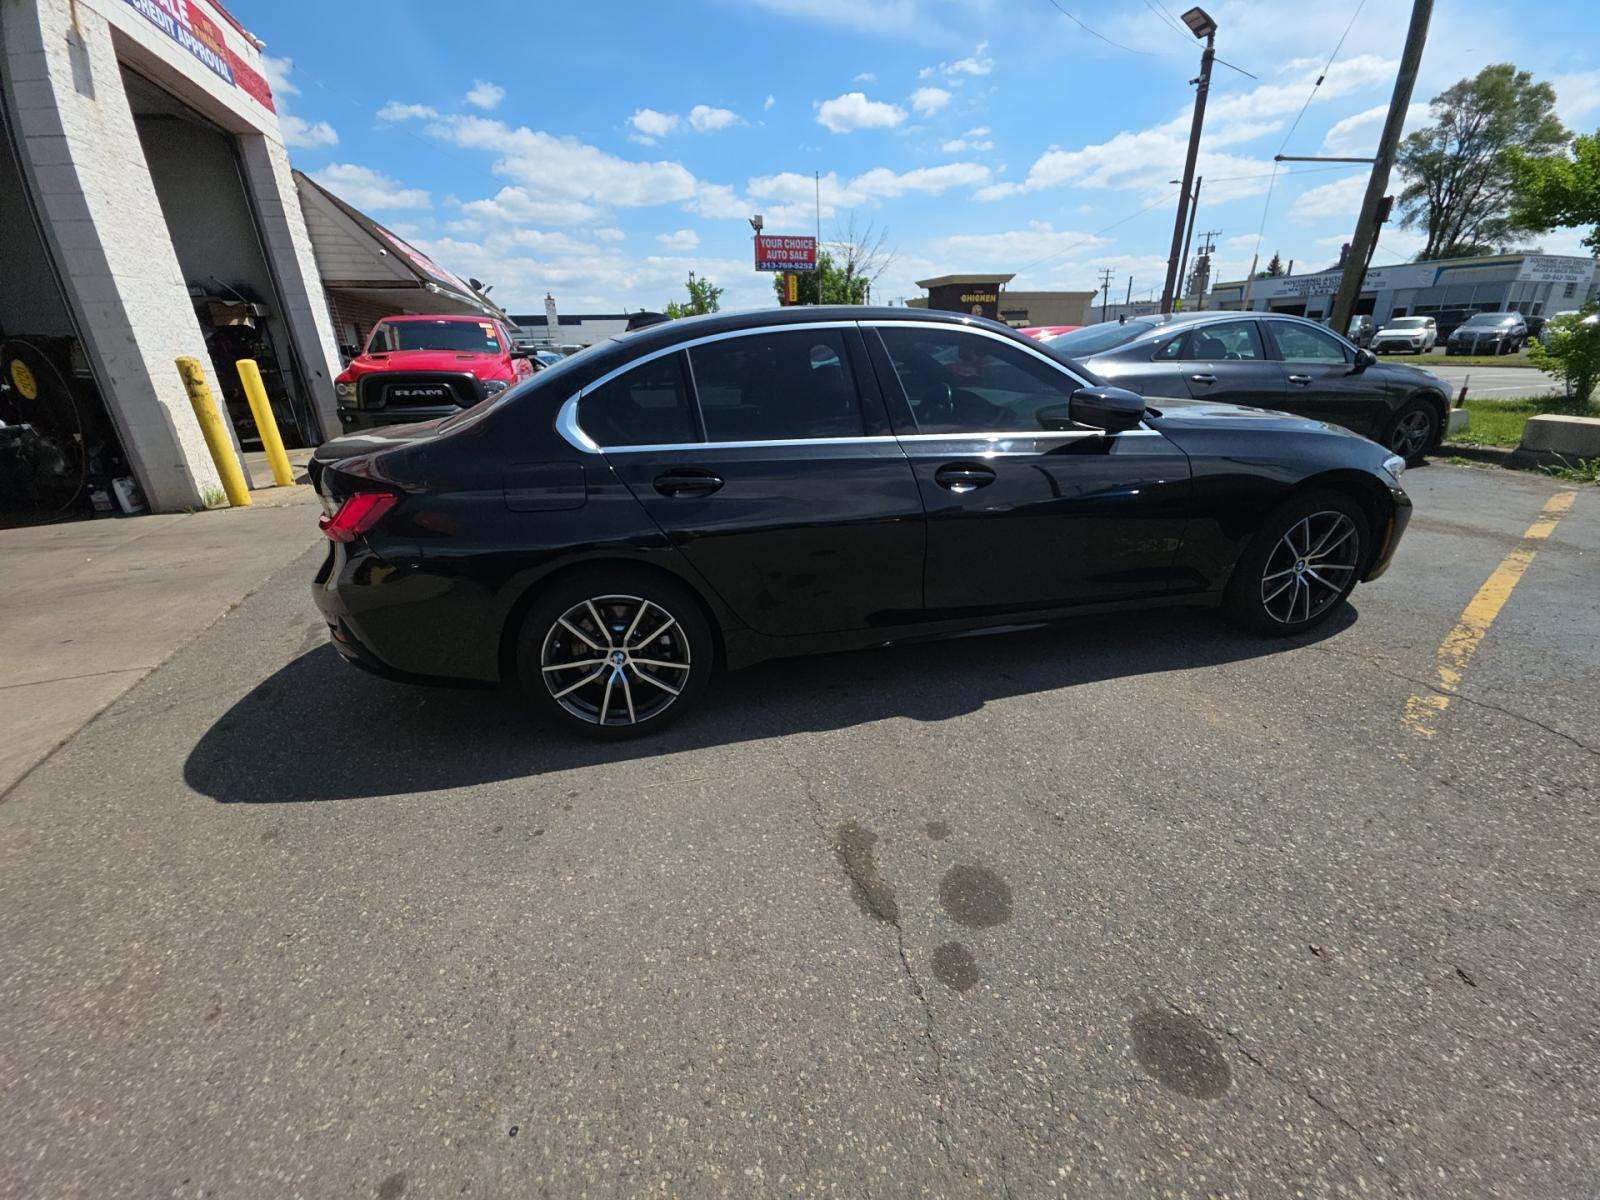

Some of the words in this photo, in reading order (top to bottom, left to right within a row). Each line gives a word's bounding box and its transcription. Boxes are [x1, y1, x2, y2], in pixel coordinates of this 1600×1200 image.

[158, 0, 193, 31] ALE
[132, 0, 175, 37] CREDIT
[177, 24, 232, 82] APPROVAL
[760, 238, 783, 248] YOUR
[784, 239, 814, 250] CHOICE
[766, 250, 788, 260] AUTO
[789, 250, 808, 260] SALE
[960, 294, 997, 302] CHICKEN
